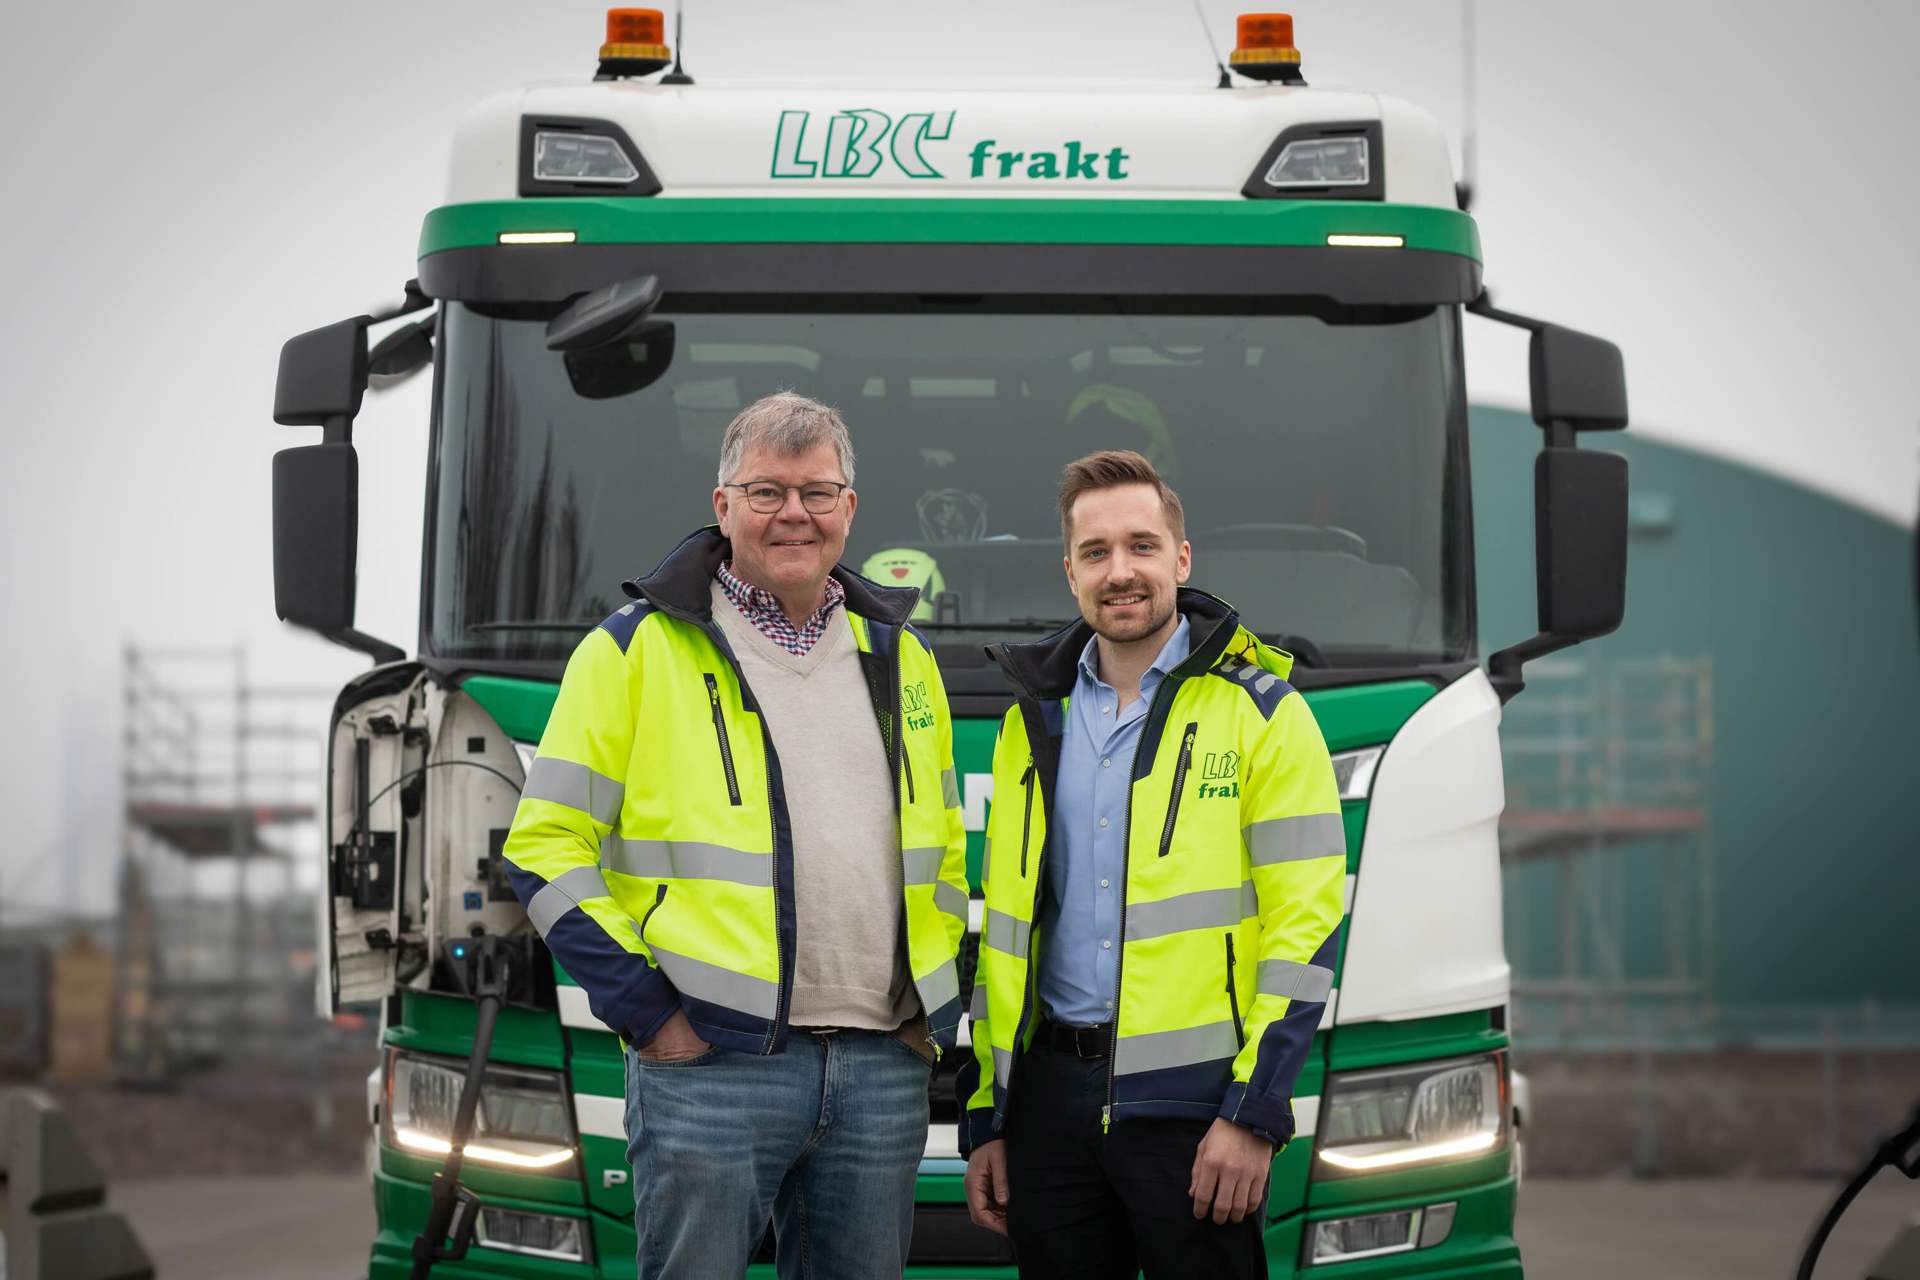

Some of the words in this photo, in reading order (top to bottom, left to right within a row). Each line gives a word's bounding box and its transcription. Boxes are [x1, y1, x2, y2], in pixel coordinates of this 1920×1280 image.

[770, 108, 957, 179] LBC
[968, 140, 1130, 180] frakt
[1202, 750, 1241, 780] LB
[1198, 782, 1240, 799] frak
